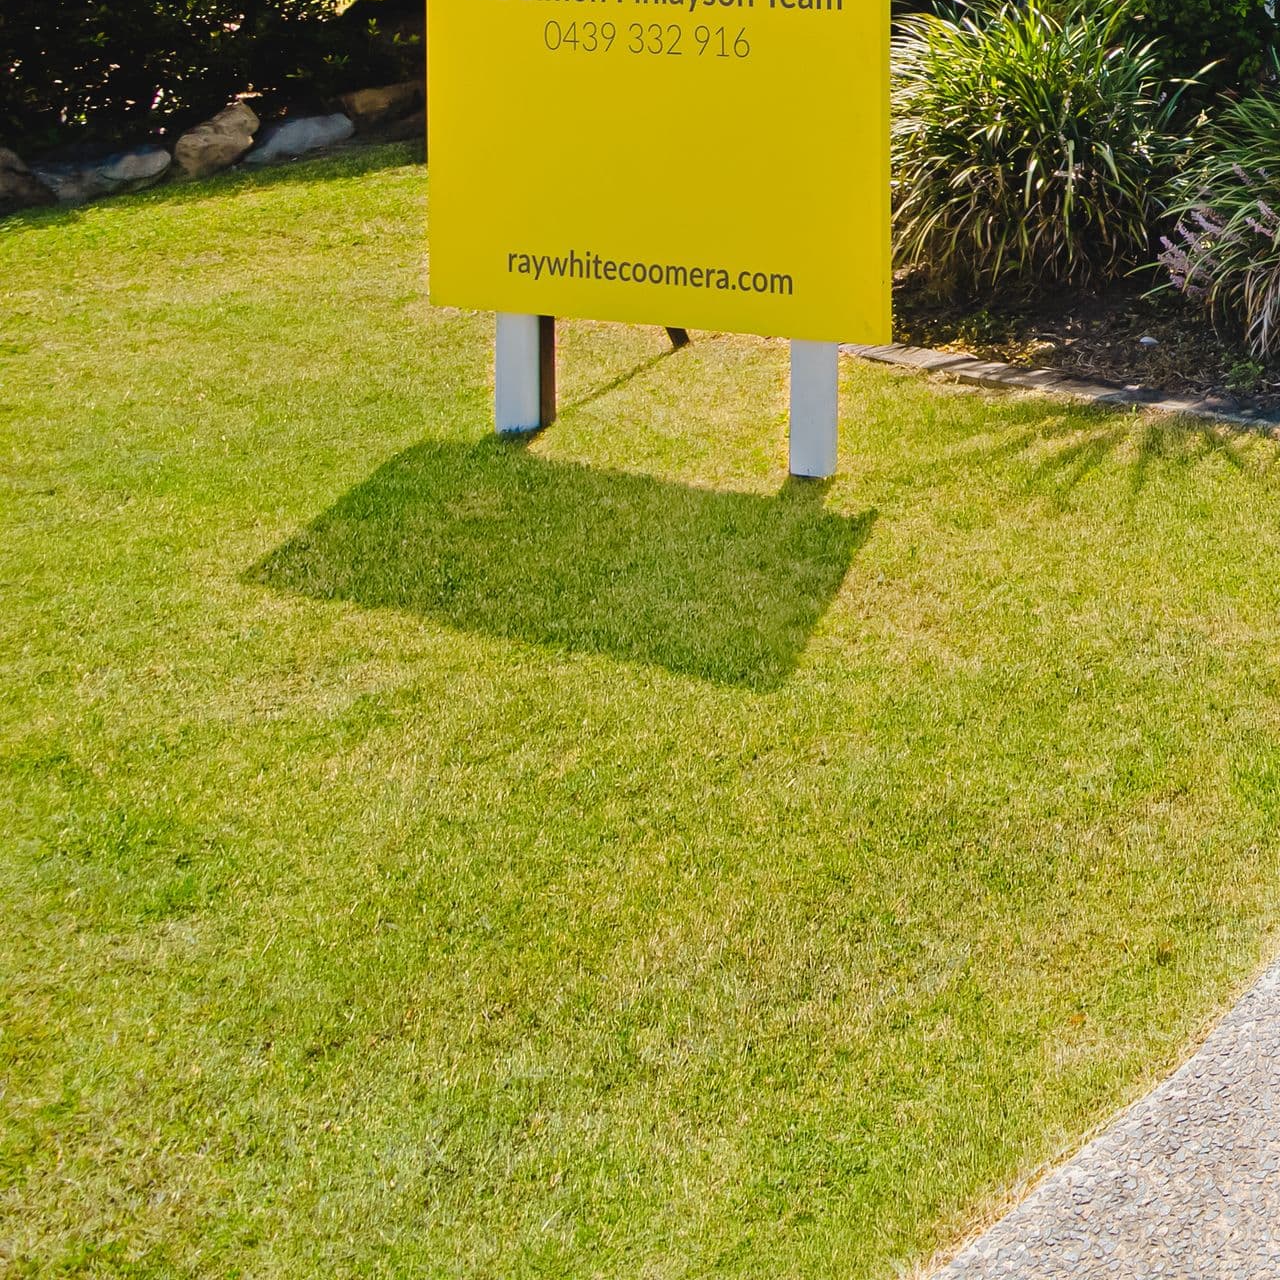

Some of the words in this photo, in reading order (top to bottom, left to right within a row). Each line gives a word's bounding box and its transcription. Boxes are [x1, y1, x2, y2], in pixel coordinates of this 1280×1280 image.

[544, 20, 617, 53] 0439
[628, 22, 683, 56] 332
[694, 25, 751, 59] 916
[508, 249, 793, 296] raywhitecoomera.com
